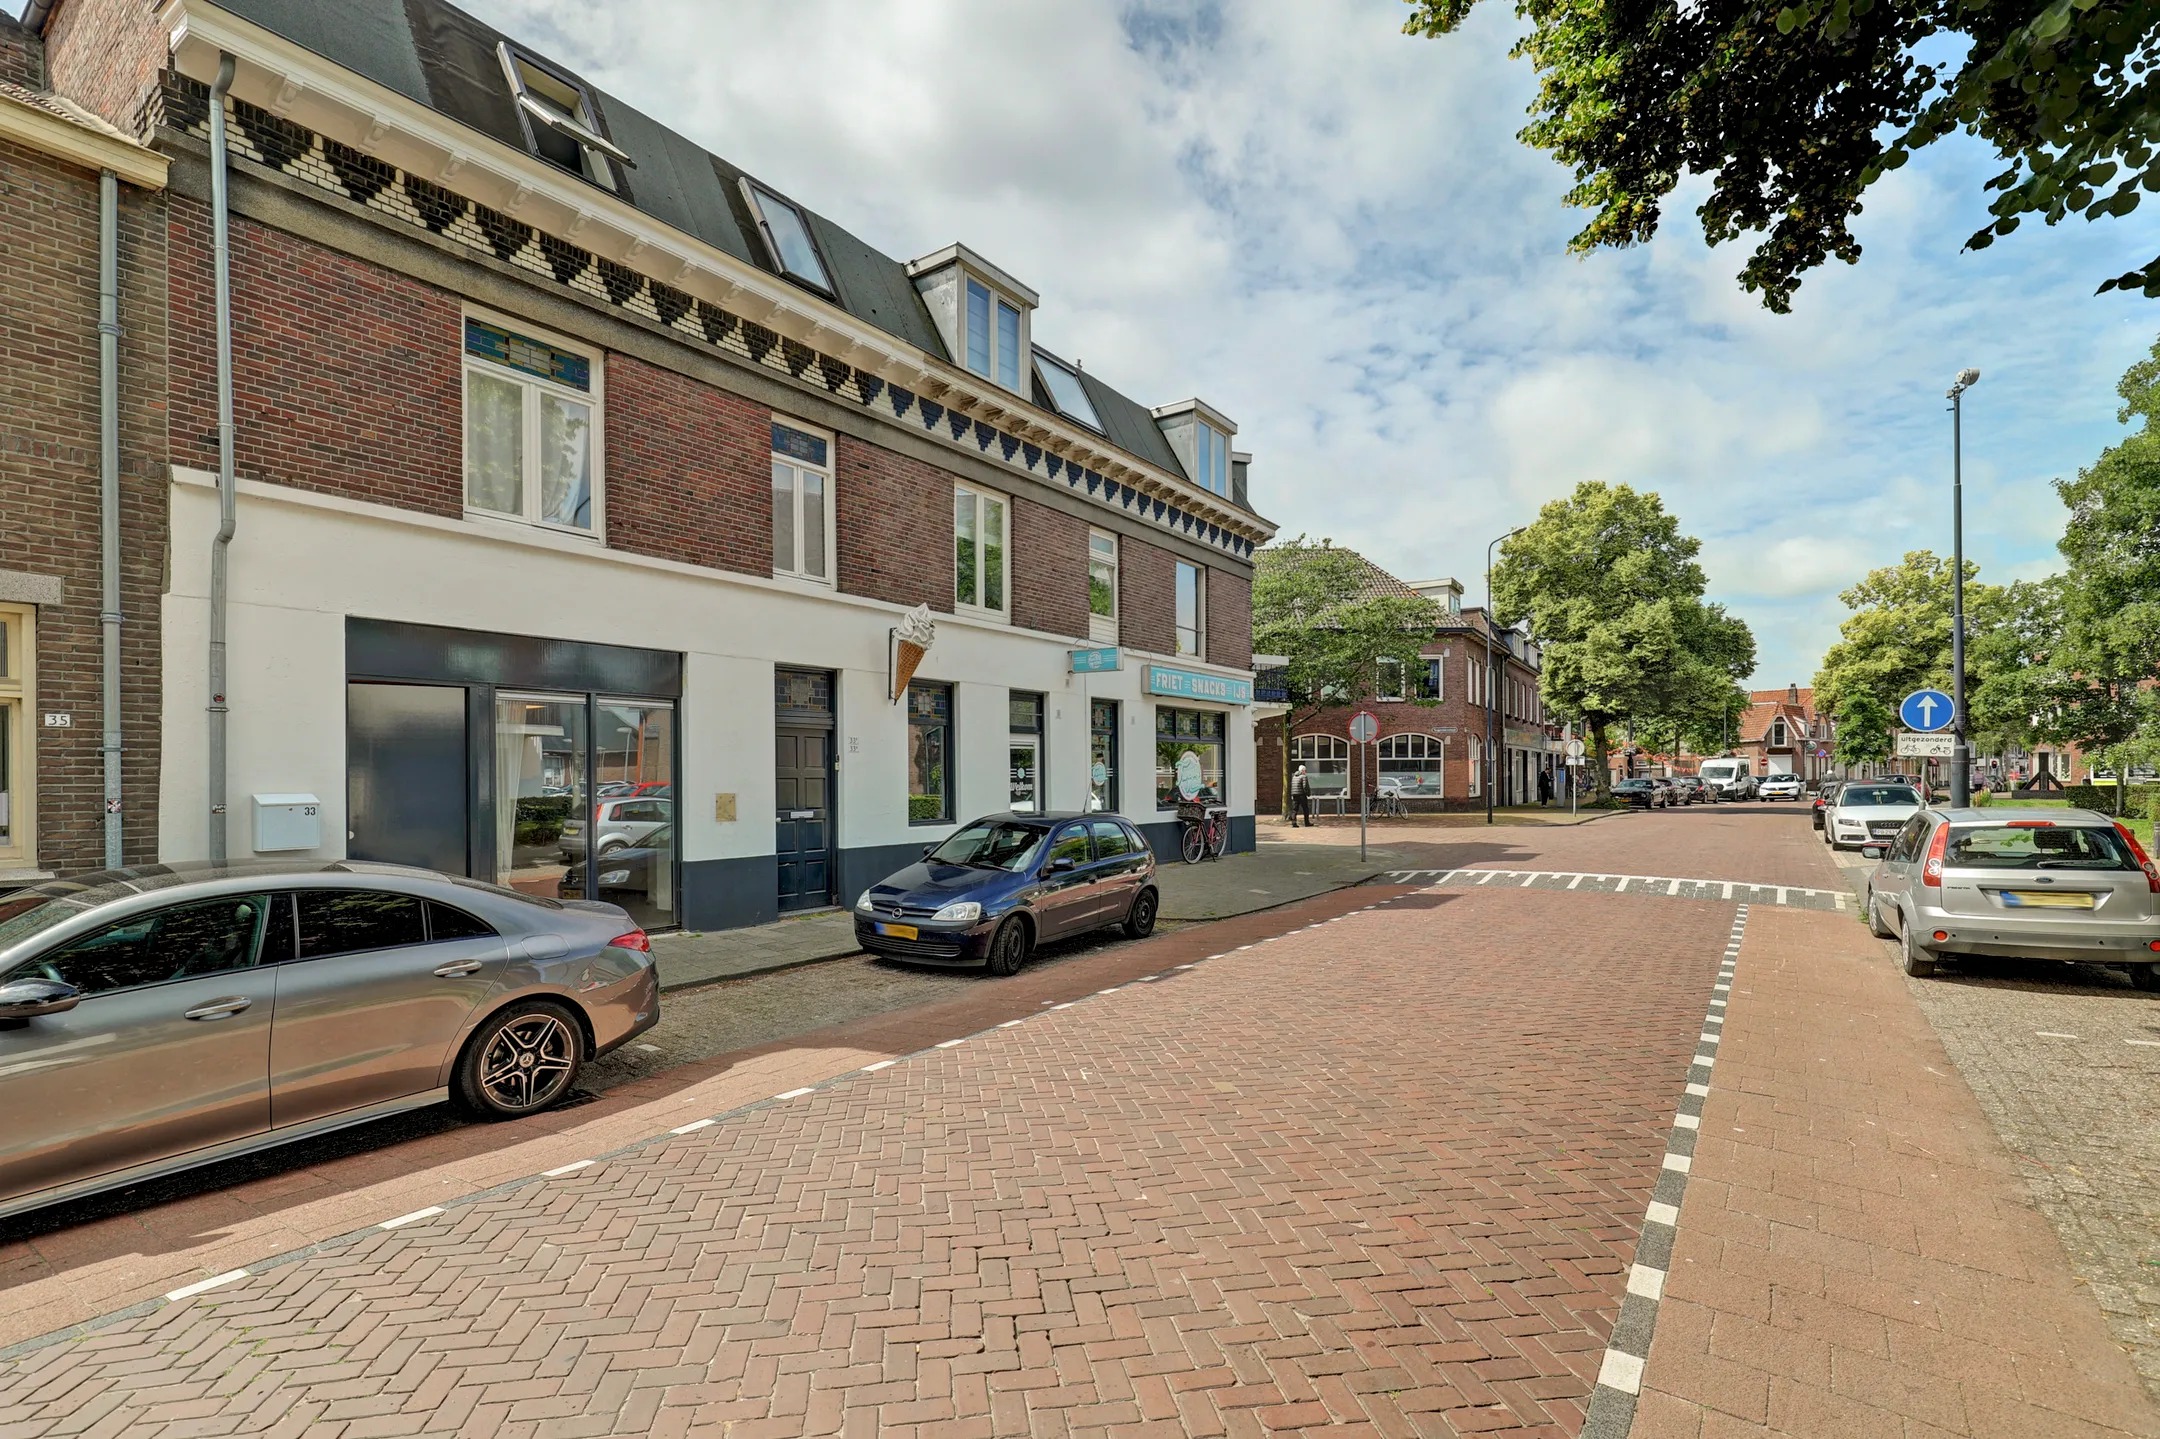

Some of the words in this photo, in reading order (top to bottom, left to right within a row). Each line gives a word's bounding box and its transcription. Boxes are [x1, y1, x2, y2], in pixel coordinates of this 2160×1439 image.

[1156, 673, 1183, 690] FRIET
[1191, 678, 1226, 697] SNACKS
[49, 715, 68, 726] 35
[304, 806, 316, 816] 33
